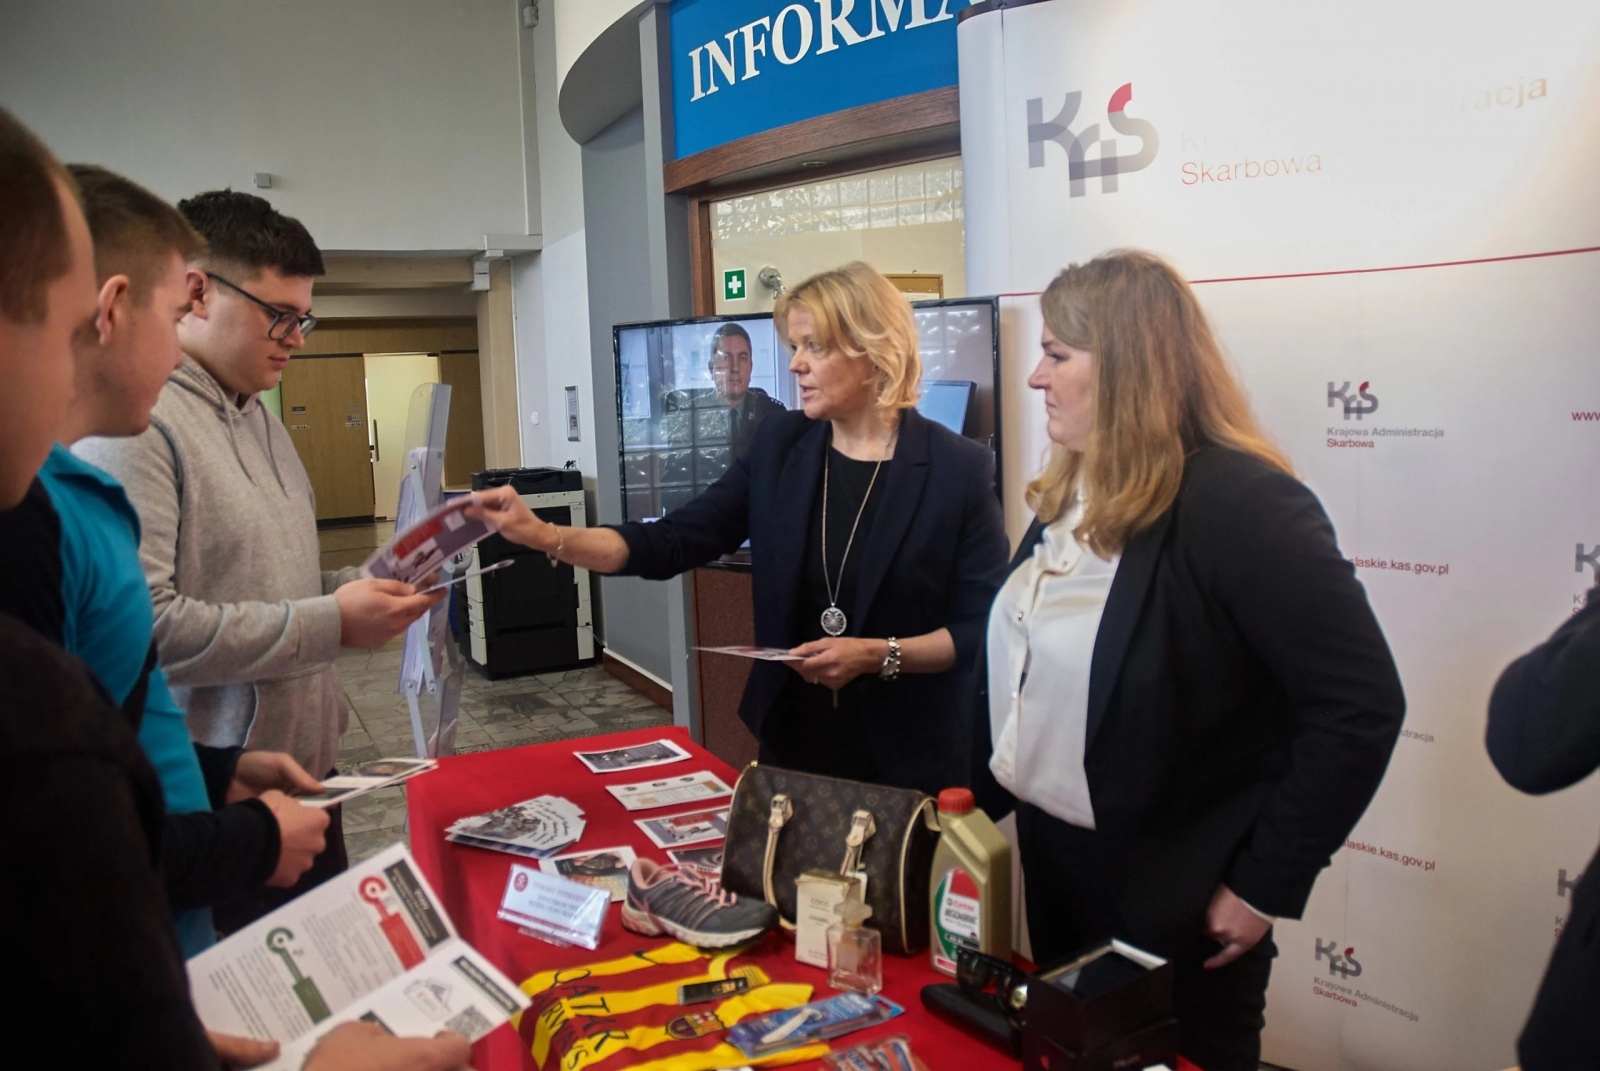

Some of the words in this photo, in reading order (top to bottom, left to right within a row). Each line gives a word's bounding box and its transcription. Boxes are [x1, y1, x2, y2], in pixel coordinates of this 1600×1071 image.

[688, 0, 986, 102] INFORM
[1181, 153, 1322, 186] Skarbowa
[1327, 427, 1369, 438] Krajowa
[1372, 427, 1445, 439] Administracja
[1327, 438, 1375, 449] Skarbowa
[1312, 985, 1358, 1008] Skarbowa
[1313, 976, 1353, 996] Krajowa
[1354, 989, 1420, 1022] Administracja
